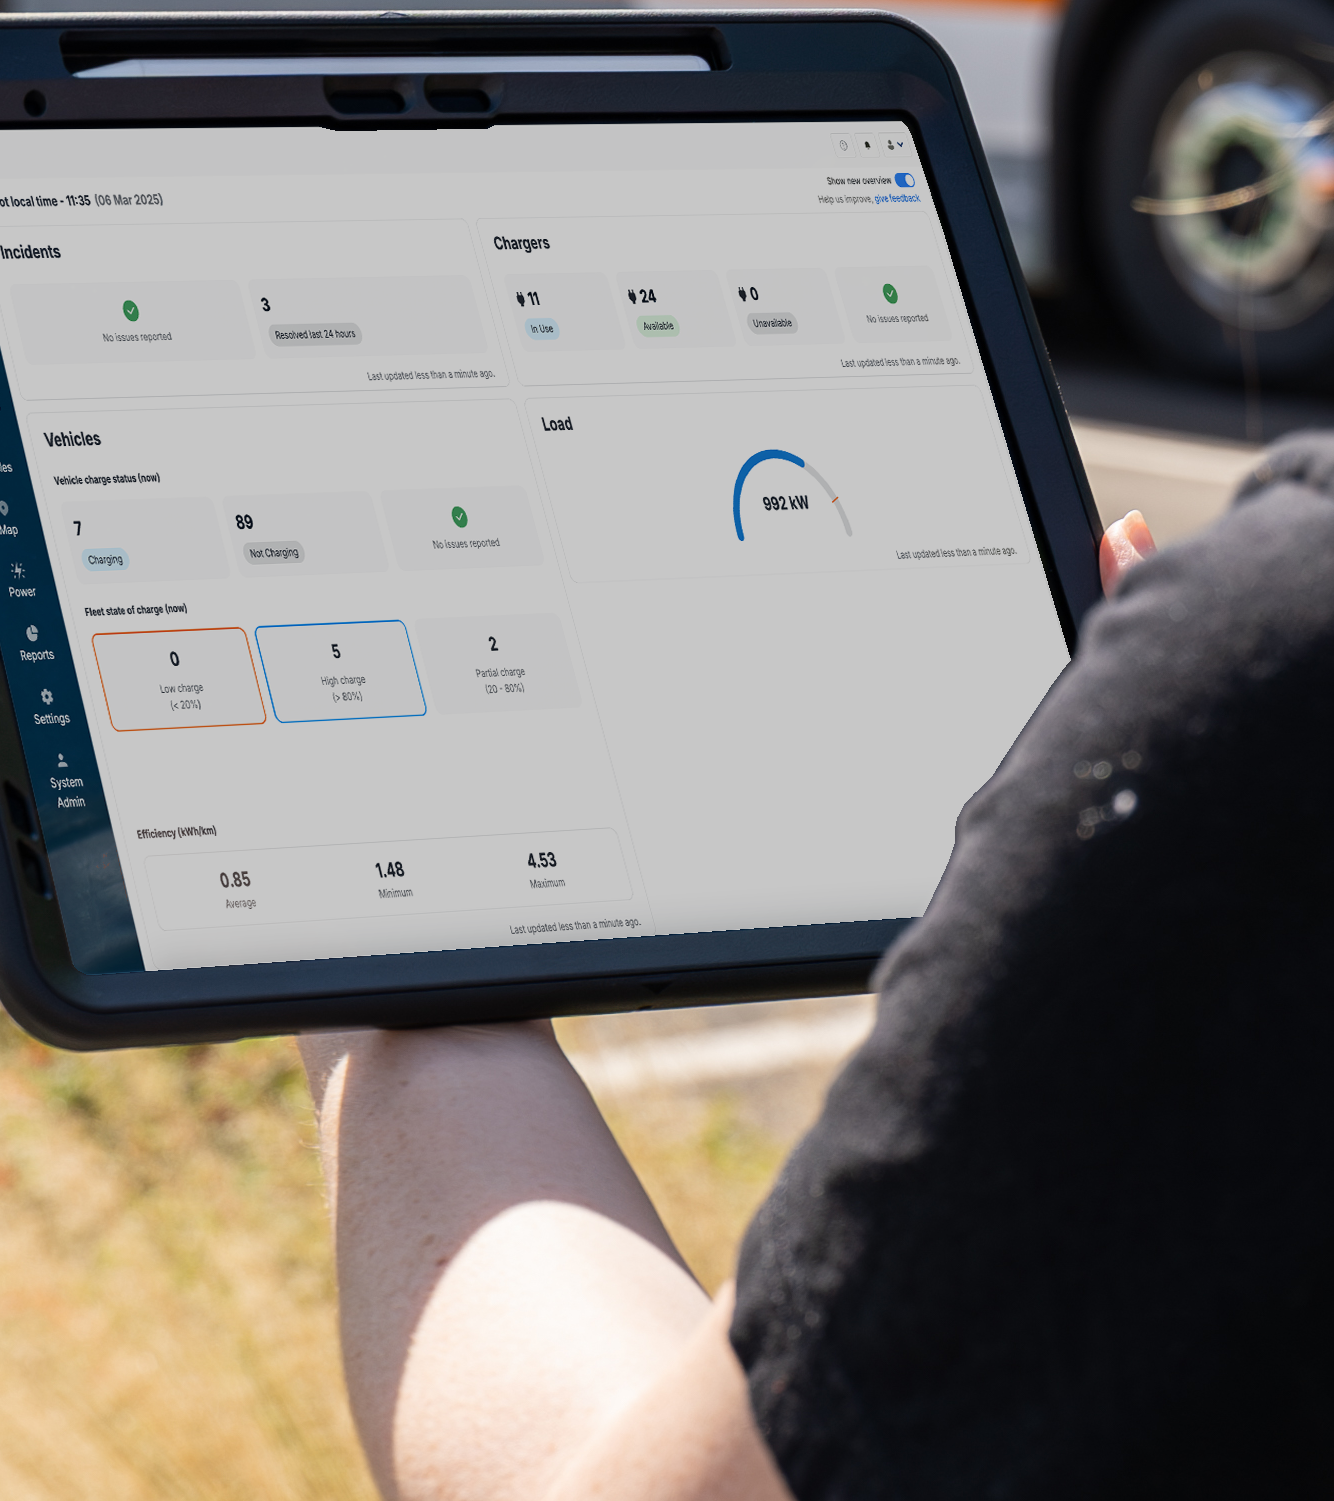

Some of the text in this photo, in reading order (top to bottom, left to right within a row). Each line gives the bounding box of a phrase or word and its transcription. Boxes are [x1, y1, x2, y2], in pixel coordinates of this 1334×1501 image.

[826, 175, 892, 186] Show new overview
[9, 195, 35, 208] local
[35, 195, 59, 207] time
[65, 194, 92, 207] 11:35
[94, 193, 112, 207] (06
[112, 194, 133, 206] Mar
[133, 192, 164, 206] 2025)
[817, 193, 922, 206] Help us improve, give feedback
[0, 243, 62, 260] Incidents
[493, 235, 551, 254] Chargers
[527, 291, 541, 306] 11
[639, 288, 657, 304] 24
[749, 286, 759, 301] 0
[260, 297, 271, 312] 3
[643, 321, 675, 331] Available
[752, 318, 793, 328] Unavailable
[865, 313, 930, 325] No issues reported
[274, 329, 356, 340] Resolved last 24 hours
[530, 324, 554, 334] In Use
[102, 331, 173, 343] No issues reported
[840, 356, 961, 369] Last updated less than a minute ago.
[366, 368, 496, 383] Last updated less than a minute ago.
[540, 415, 574, 432] Load
[42, 430, 102, 448] Vehicles
[53, 472, 161, 486] Vehicle charge status (now)
[762, 494, 809, 512] 992 kW
[72, 520, 82, 536] 7
[235, 513, 254, 530] 89
[431, 537, 501, 550] No issues reported
[87, 554, 124, 567] Charging
[249, 547, 300, 560] Not Charging
[895, 546, 1018, 561] Last updated less than a minute ago.
[8, 586, 36, 598] Power
[84, 602, 188, 617] Fleet state of charge (now)
[331, 643, 341, 659] 5
[488, 636, 499, 652] 2
[19, 649, 55, 664] Reports
[169, 650, 180, 667] 0
[475, 667, 526, 679] Partial charge
[159, 683, 204, 695] Low charge
[320, 675, 366, 688] High charge
[484, 684, 499, 695] (20
[504, 682, 525, 693] 80%)
[332, 690, 363, 704] (> 80%)
[170, 698, 202, 712] (< 20%)
[33, 712, 71, 727] Settings
[49, 776, 84, 791] System
[57, 795, 86, 809] Admin
[136, 824, 217, 840] Efficiency (kWh/km)
[527, 851, 557, 869] 4.53
[375, 860, 405, 879] 1.48
[219, 870, 251, 889] 0.85
[529, 878, 566, 889] Maximum
[377, 887, 414, 899] Minimum
[225, 898, 257, 910] Average
[509, 918, 642, 936] Last updated less than a minute ago.
